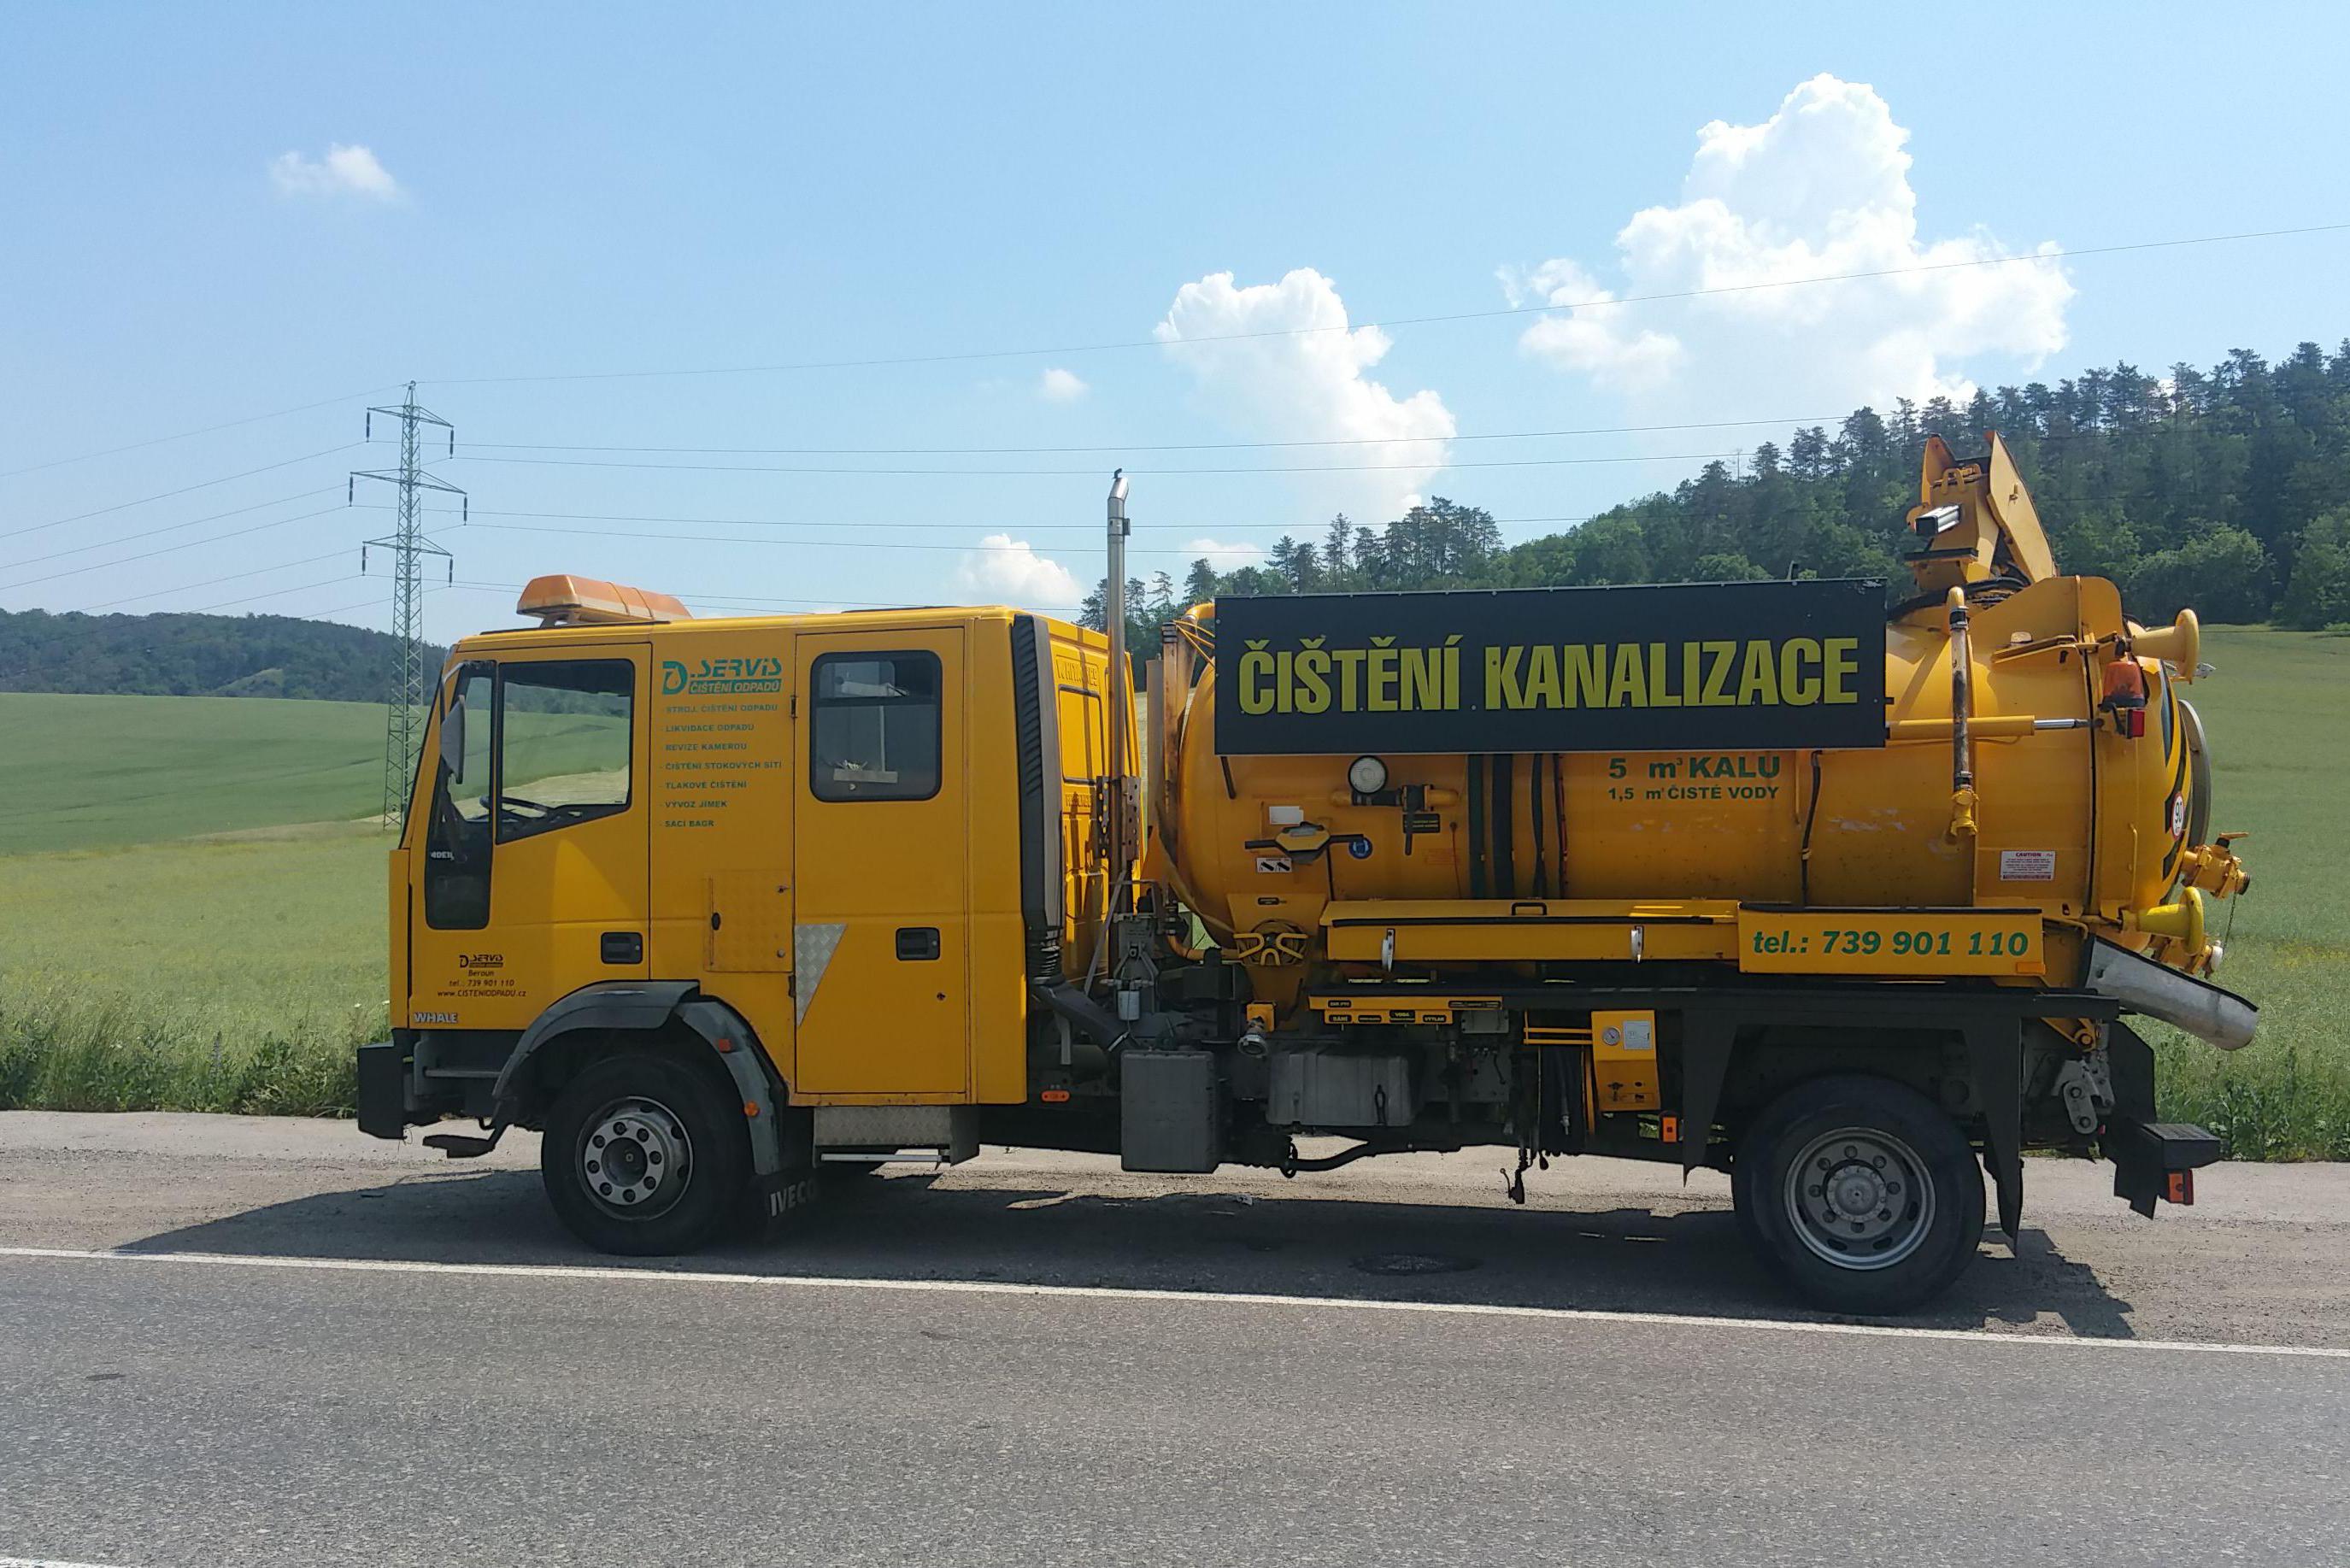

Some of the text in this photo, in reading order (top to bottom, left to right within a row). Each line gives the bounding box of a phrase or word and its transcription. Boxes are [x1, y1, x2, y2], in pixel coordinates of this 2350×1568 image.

[1238, 634, 1859, 715] ČIŠTĚNÍ KANALIZACE
[666, 724, 716, 732] LIKVIDACE
[1609, 758, 1627, 779] 5
[1689, 756, 1780, 779] KALU
[1608, 787, 1634, 802] 1,5
[1667, 784, 1722, 800] ČISTÉ
[1728, 786, 1779, 800] VODY
[1753, 931, 2029, 956] tel.: 739 901 110
[414, 1012, 458, 1024] WHALE
[770, 1177, 817, 1216] IVECO
